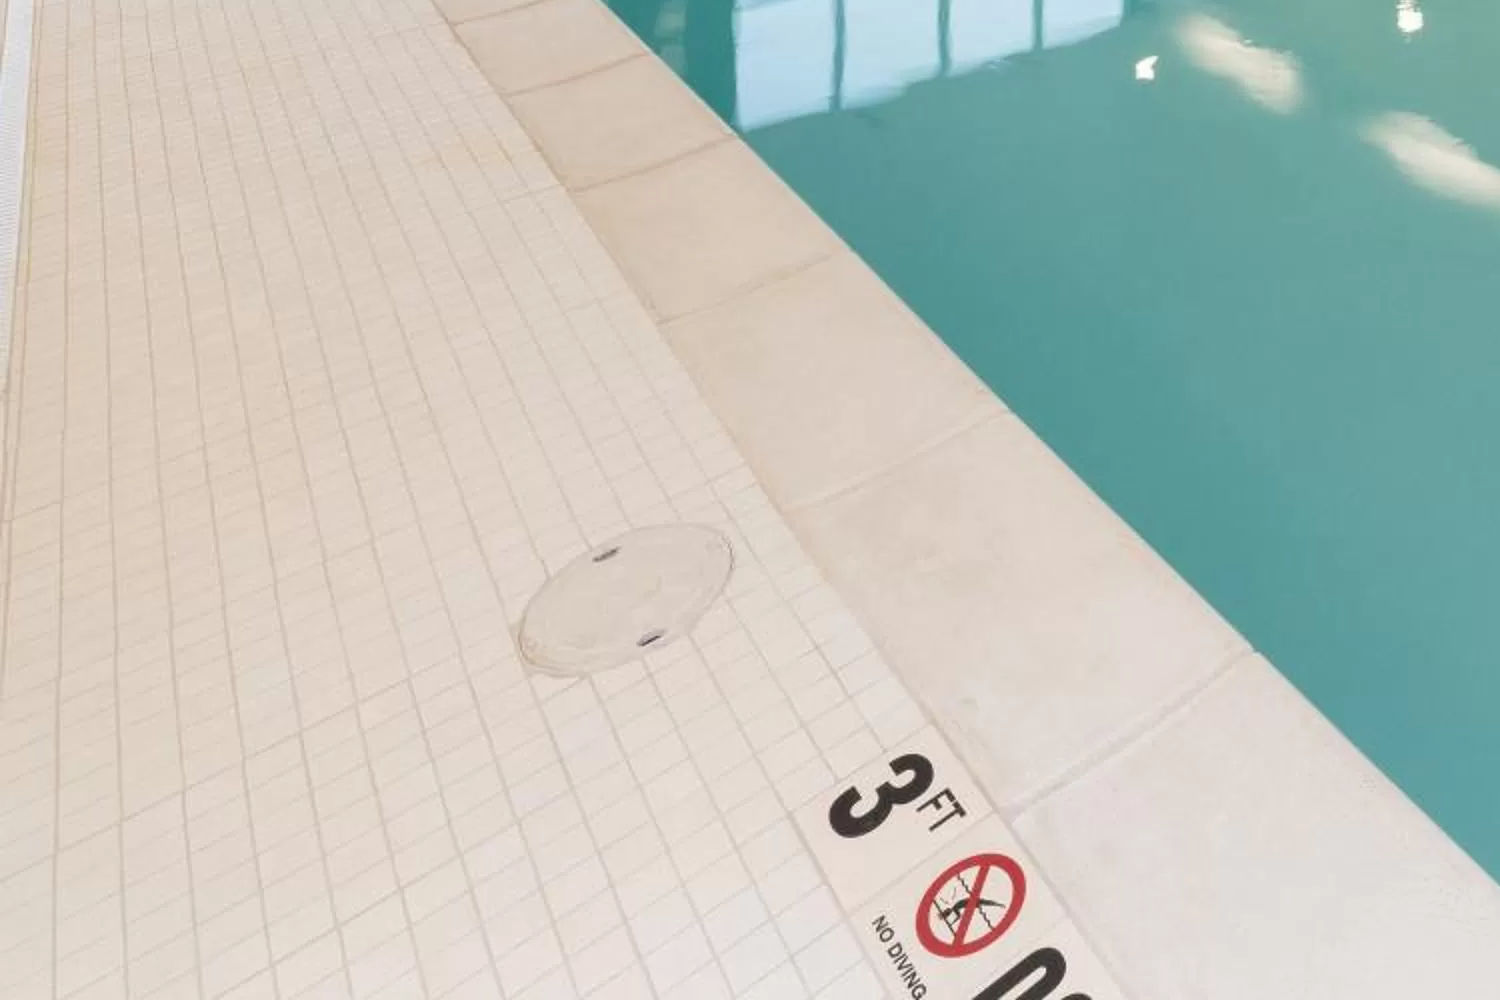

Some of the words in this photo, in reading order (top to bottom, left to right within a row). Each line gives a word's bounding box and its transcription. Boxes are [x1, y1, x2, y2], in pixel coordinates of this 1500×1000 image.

[828, 753, 935, 838] 3
[915, 787, 967, 832] FT
[871, 914, 895, 944] NO
[886, 942, 928, 1000] DIVING
